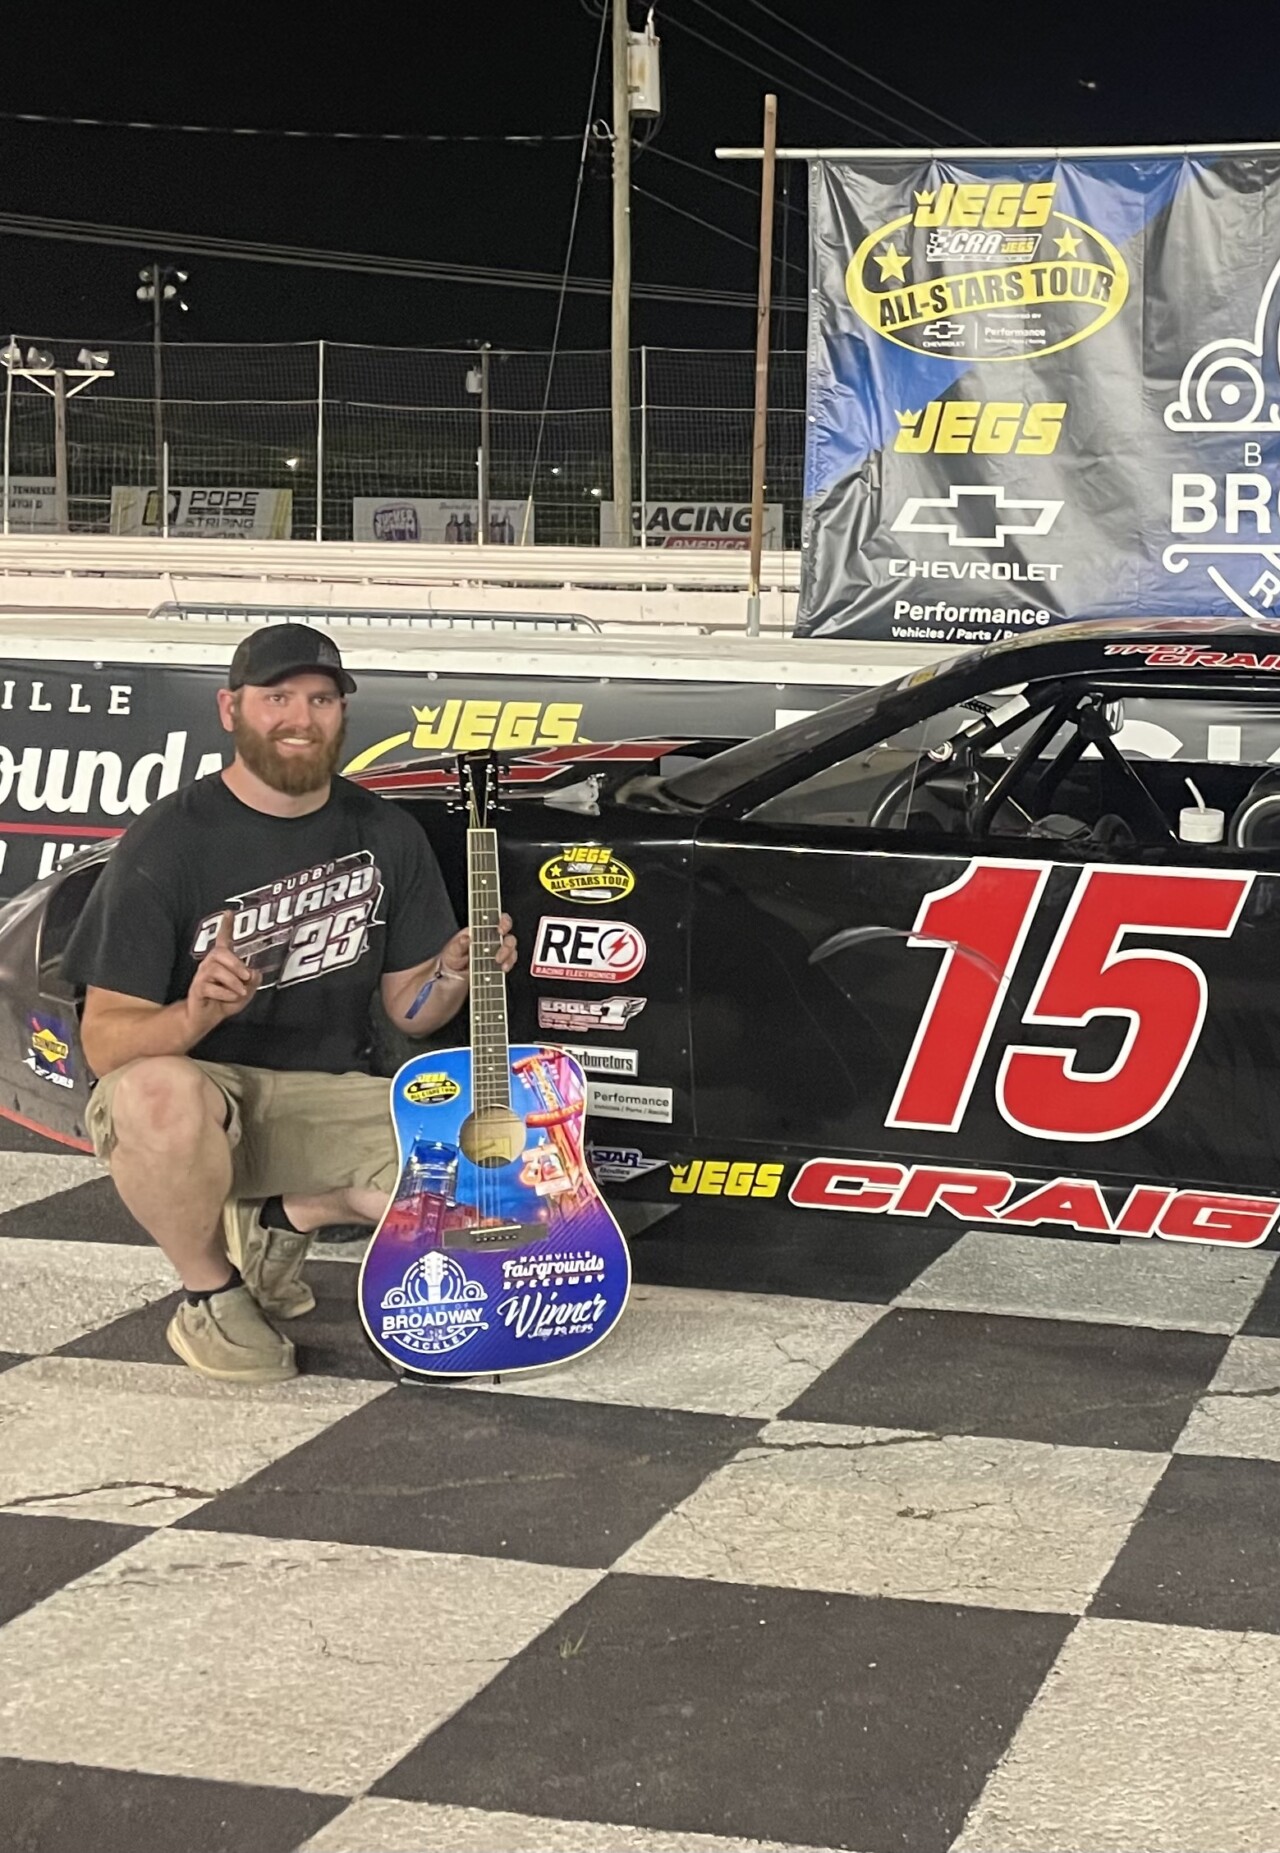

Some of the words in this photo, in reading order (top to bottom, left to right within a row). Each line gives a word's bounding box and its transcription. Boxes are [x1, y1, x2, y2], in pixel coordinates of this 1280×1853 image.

[914, 183, 1057, 227] JEGS
[948, 231, 1002, 253] CRA
[880, 271, 1024, 327] ALL-STARS
[1031, 267, 1114, 303] TOUR
[985, 327, 1046, 336] Performance
[893, 402, 1067, 454] JEGS
[190, 491, 259, 506] POPE
[889, 559, 1063, 581] CHEVROLET
[893, 600, 1050, 625] Performance
[892, 627, 945, 639] Vehicles
[956, 629, 991, 641] Parts
[1, 681, 132, 714] ILLE
[412, 700, 583, 750] JEGS
[564, 848, 613, 863] JEGS
[273, 862, 335, 895] BUBBA
[551, 876, 600, 890] ALL-STARS
[603, 875, 630, 888] TOUR
[193, 866, 376, 952] POLLARD
[279, 905, 366, 983] 26
[536, 967, 563, 976] RACING
[565, 968, 617, 980] ELECTRONICS
[884, 857, 1257, 1142] 15
[594, 1091, 669, 1107] Performance
[592, 1149, 640, 1168] STAR
[670, 1160, 784, 1197] JEGS
[502, 1255, 604, 1280] Fairgrounds
[520, 1251, 591, 1263] NASHVILLE
[503, 1274, 604, 1290] SPEEDWAY
[383, 1308, 483, 1331] BROADWAY
[497, 1292, 607, 1338] Winner
[403, 1330, 466, 1349] RACKLEY
